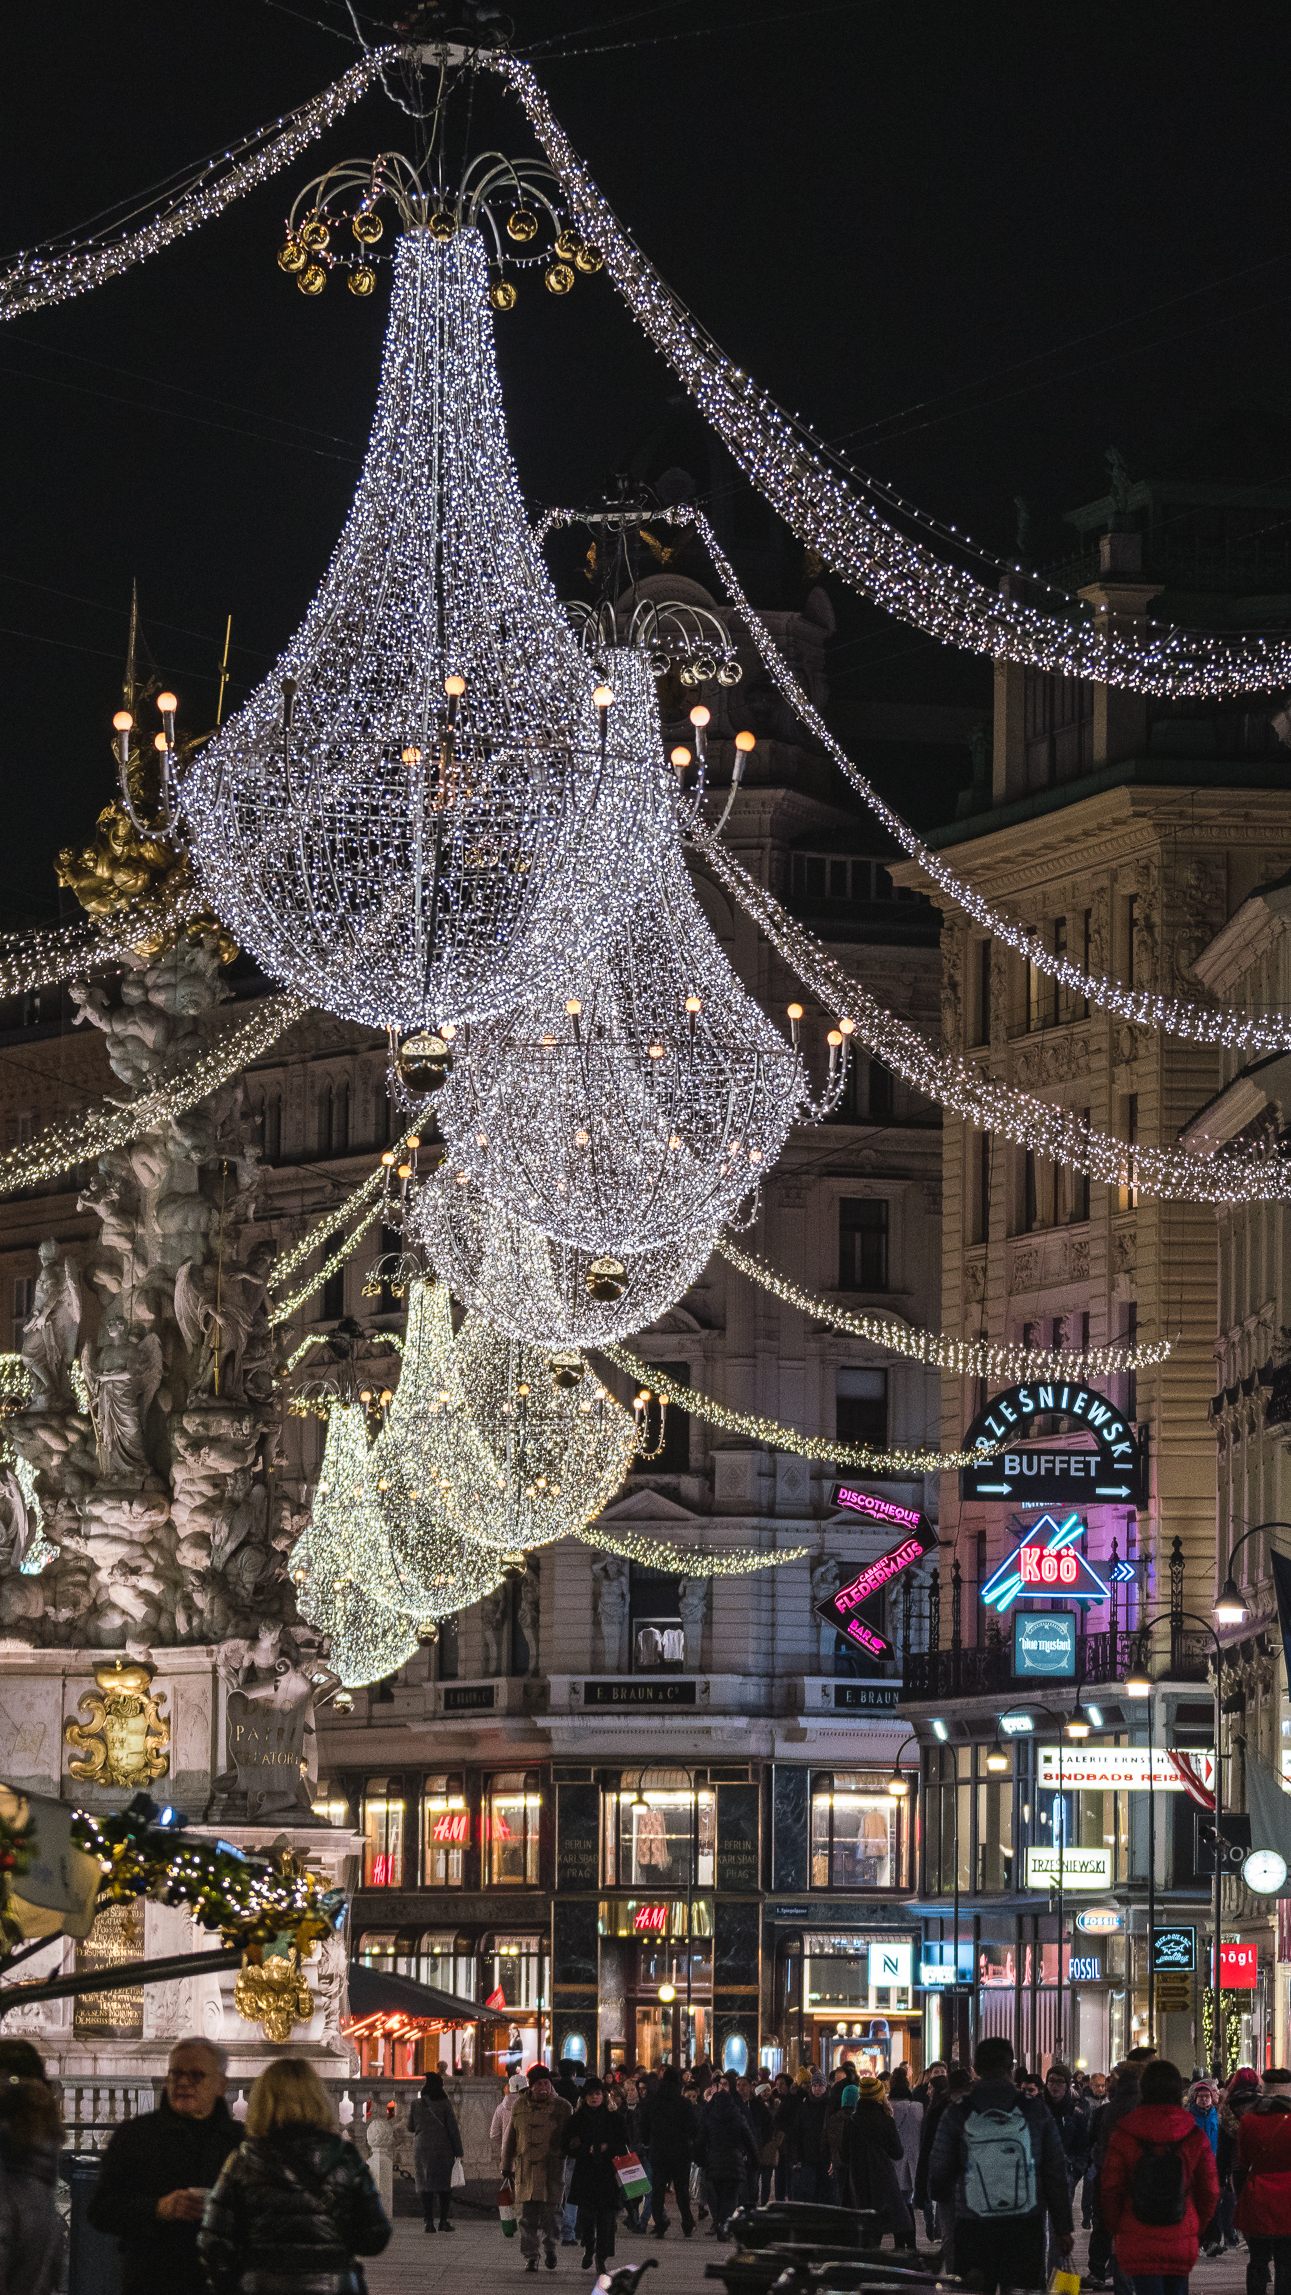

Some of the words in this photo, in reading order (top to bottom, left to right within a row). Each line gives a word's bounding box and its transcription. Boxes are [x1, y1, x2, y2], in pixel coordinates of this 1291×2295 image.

[1004, 1454, 1100, 1477] BUFFET
[838, 1487, 921, 1525] DISCOTHEQUE
[835, 1541, 924, 1614] FLEDERMAUS
[859, 1556, 889, 1582] CABARET
[849, 1618, 872, 1642] BAR
[612, 1687, 654, 1700] BRAUN
[846, 1690, 856, 1703] E.
[860, 1691, 899, 1704] BRAUN
[1043, 1772, 1133, 1782] SINDBADS
[433, 1815, 467, 1842] H&M
[565, 1840, 592, 1850] BERLIN
[724, 1840, 752, 1850] BERLIN
[635, 1907, 667, 1929] H&M
[1084, 1916, 1119, 1926] FOSSIL
[1068, 1958, 1099, 1979] FOSSIL
